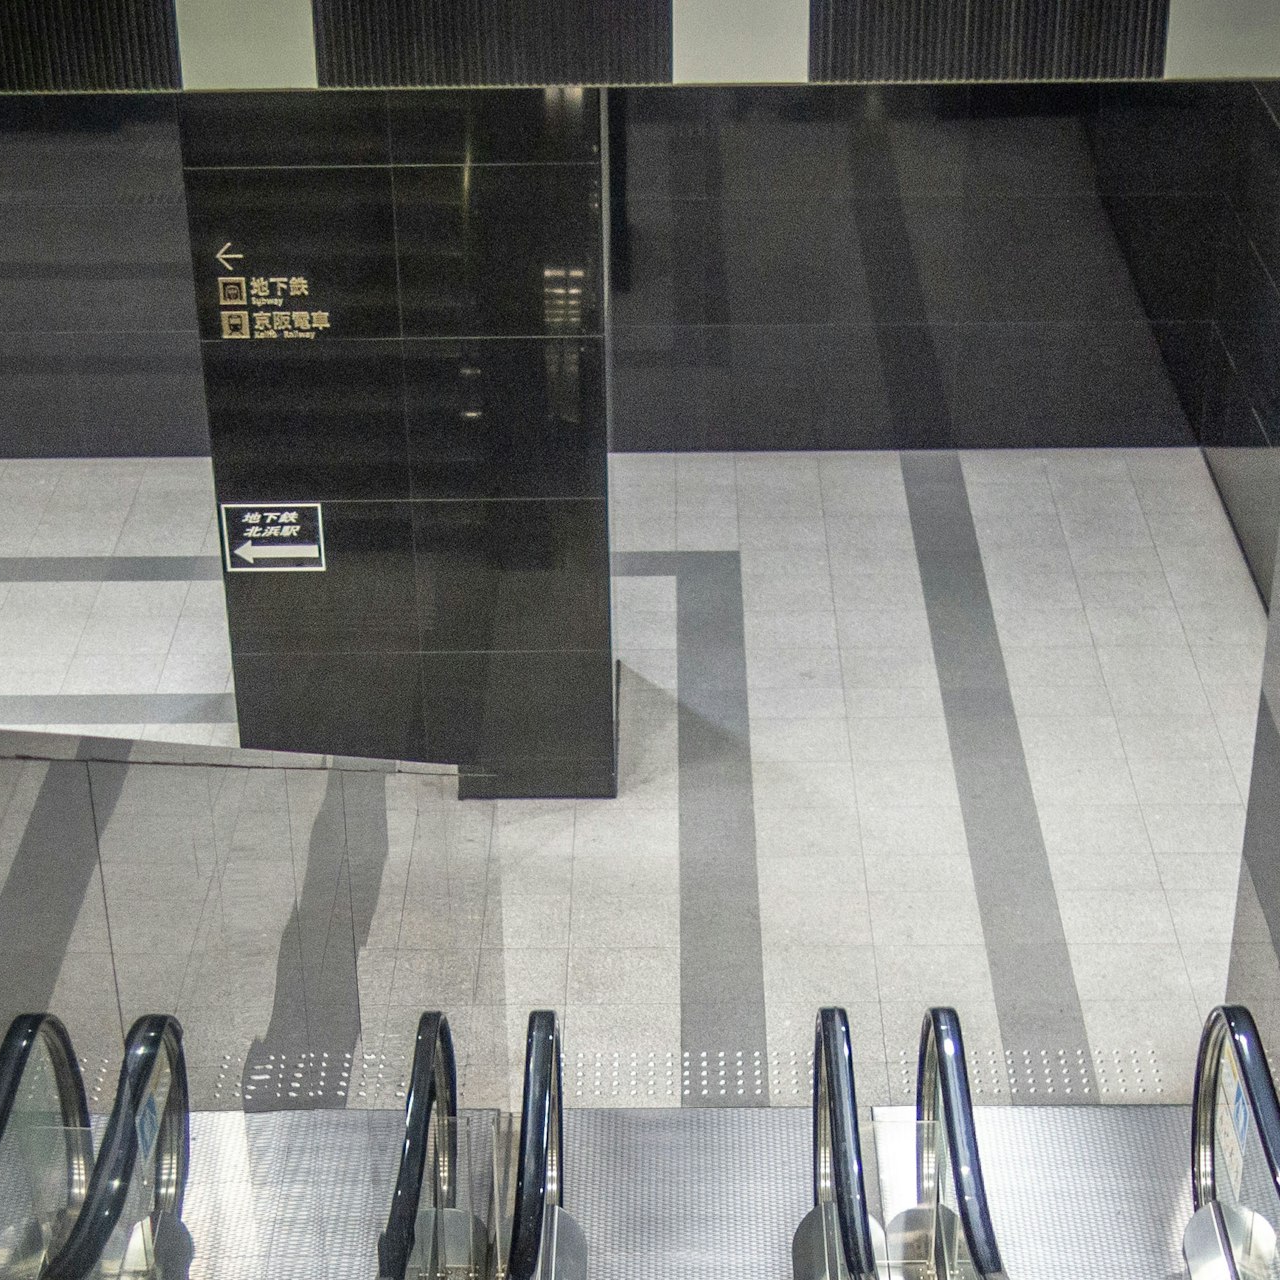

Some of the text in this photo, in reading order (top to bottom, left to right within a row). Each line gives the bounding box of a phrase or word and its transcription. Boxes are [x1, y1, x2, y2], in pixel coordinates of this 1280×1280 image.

[250, 277, 309, 296] 地下鉄
[252, 311, 330, 330] 京阪電車
[241, 511, 299, 524] 地下鉄
[243, 525, 301, 537] 北浜駅
